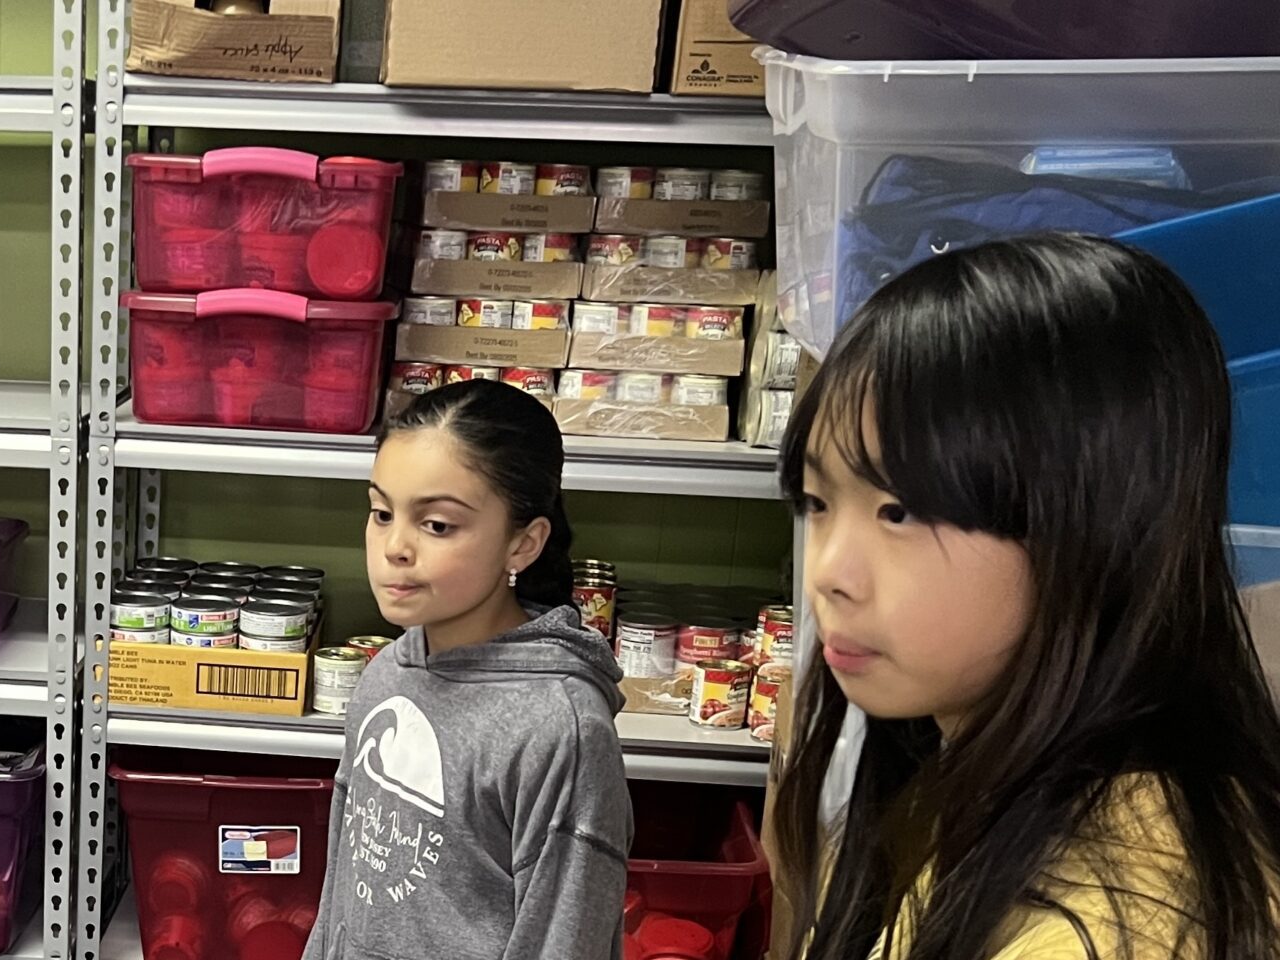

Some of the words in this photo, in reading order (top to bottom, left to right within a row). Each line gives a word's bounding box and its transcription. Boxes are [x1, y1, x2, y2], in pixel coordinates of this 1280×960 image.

[477, 237, 501, 246] PASTA
[703, 315, 728, 325] PASTA
[386, 831, 444, 902] WAVES
